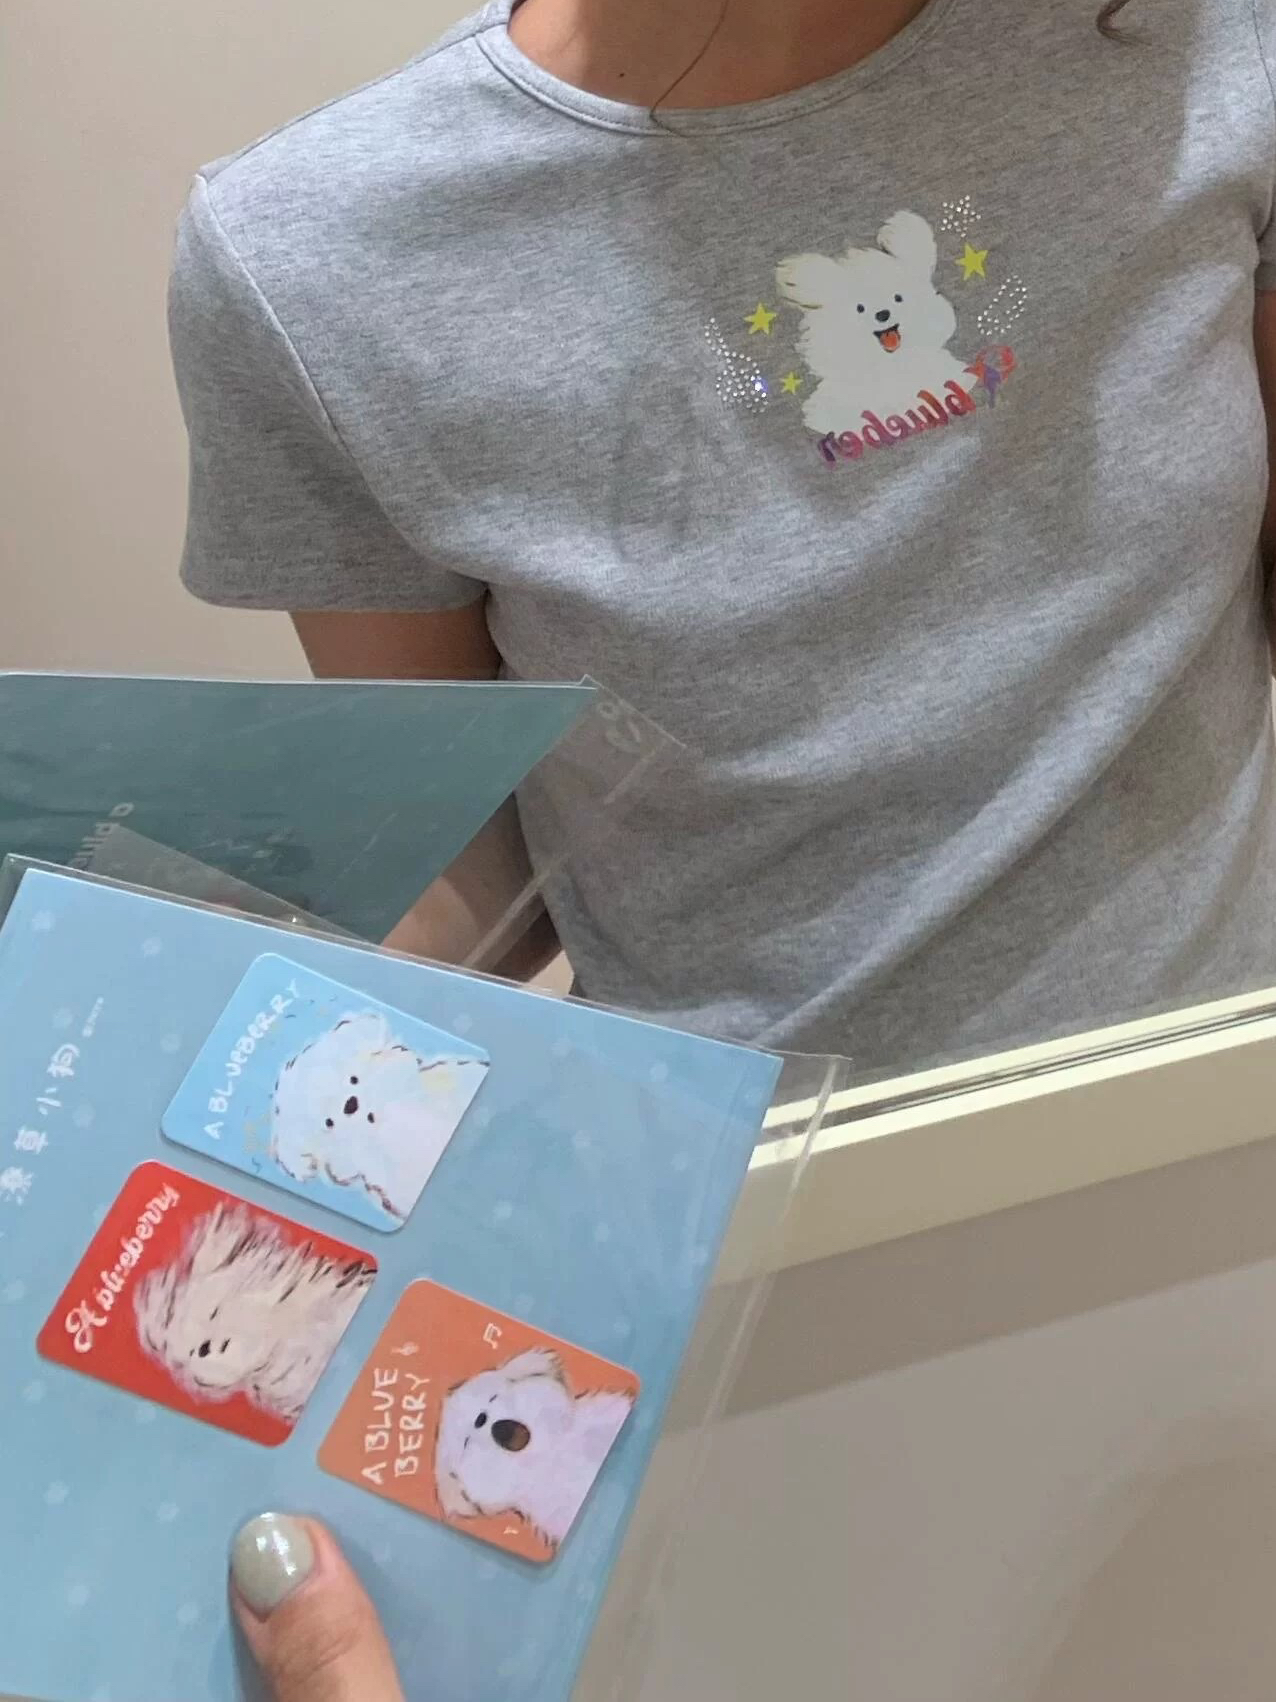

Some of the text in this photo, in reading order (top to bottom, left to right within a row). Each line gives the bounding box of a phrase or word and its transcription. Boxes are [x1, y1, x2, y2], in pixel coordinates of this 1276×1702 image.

[203, 1121, 224, 1140] A
[361, 1368, 398, 1485] A BLUE
[394, 1373, 431, 1478] BERRY
